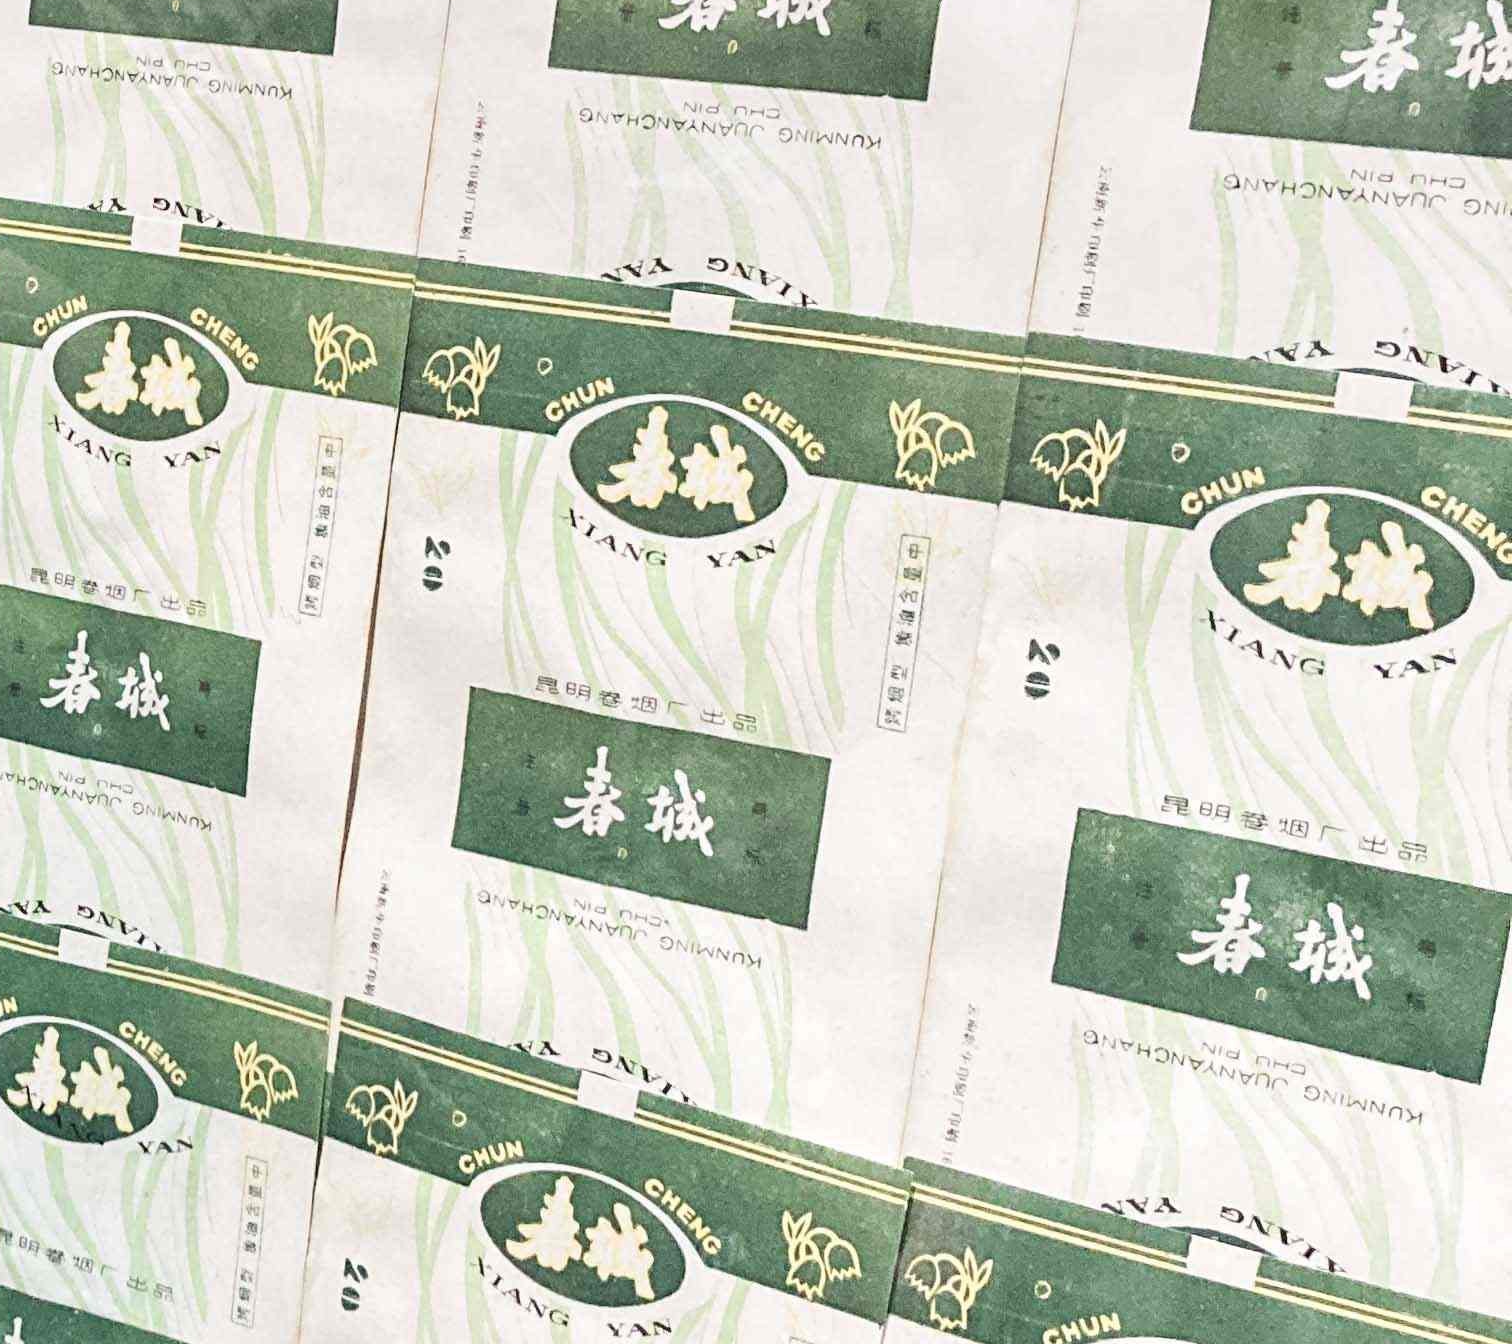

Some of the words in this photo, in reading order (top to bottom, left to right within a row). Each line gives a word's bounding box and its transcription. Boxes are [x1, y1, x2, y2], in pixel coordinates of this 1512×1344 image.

[209, 80, 293, 98] KUNMING
[778, 127, 882, 150] KUNMING
[602, 257, 673, 284] YAN
[707, 256, 817, 309] XIANG
[32, 296, 87, 337] CHUN
[190, 308, 259, 372] CHENG
[48, 415, 132, 468] XIANG
[163, 440, 221, 469] YAN
[545, 377, 616, 422] CHUN
[741, 391, 826, 462] CHENG
[559, 507, 667, 567] XIANG
[707, 538, 777, 569] YAN
[1180, 467, 1265, 516] CHUN
[1421, 486, 1512, 566] CHENG
[1200, 608, 1327, 677] XIANG
[1373, 648, 1458, 680] YAN
[40, 630, 171, 731] 春城
[133, 801, 212, 830] KUNMING
[553, 745, 713, 856] 春城
[659, 935, 763, 969] KUNMING
[1176, 873, 1373, 999] 春城
[119, 1021, 187, 1087] CHENG
[1304, 1086, 1423, 1125] KUNMING
[138, 1138, 194, 1155] YAN
[458, 1140, 524, 1176] CHUN
[644, 1177, 722, 1257] CHENG
[1100, 1196, 1182, 1216] YAN
[1221, 1204, 1348, 1274] XIANG
[471, 1255, 571, 1328] XIANG
[607, 1317, 673, 1338] YAN
